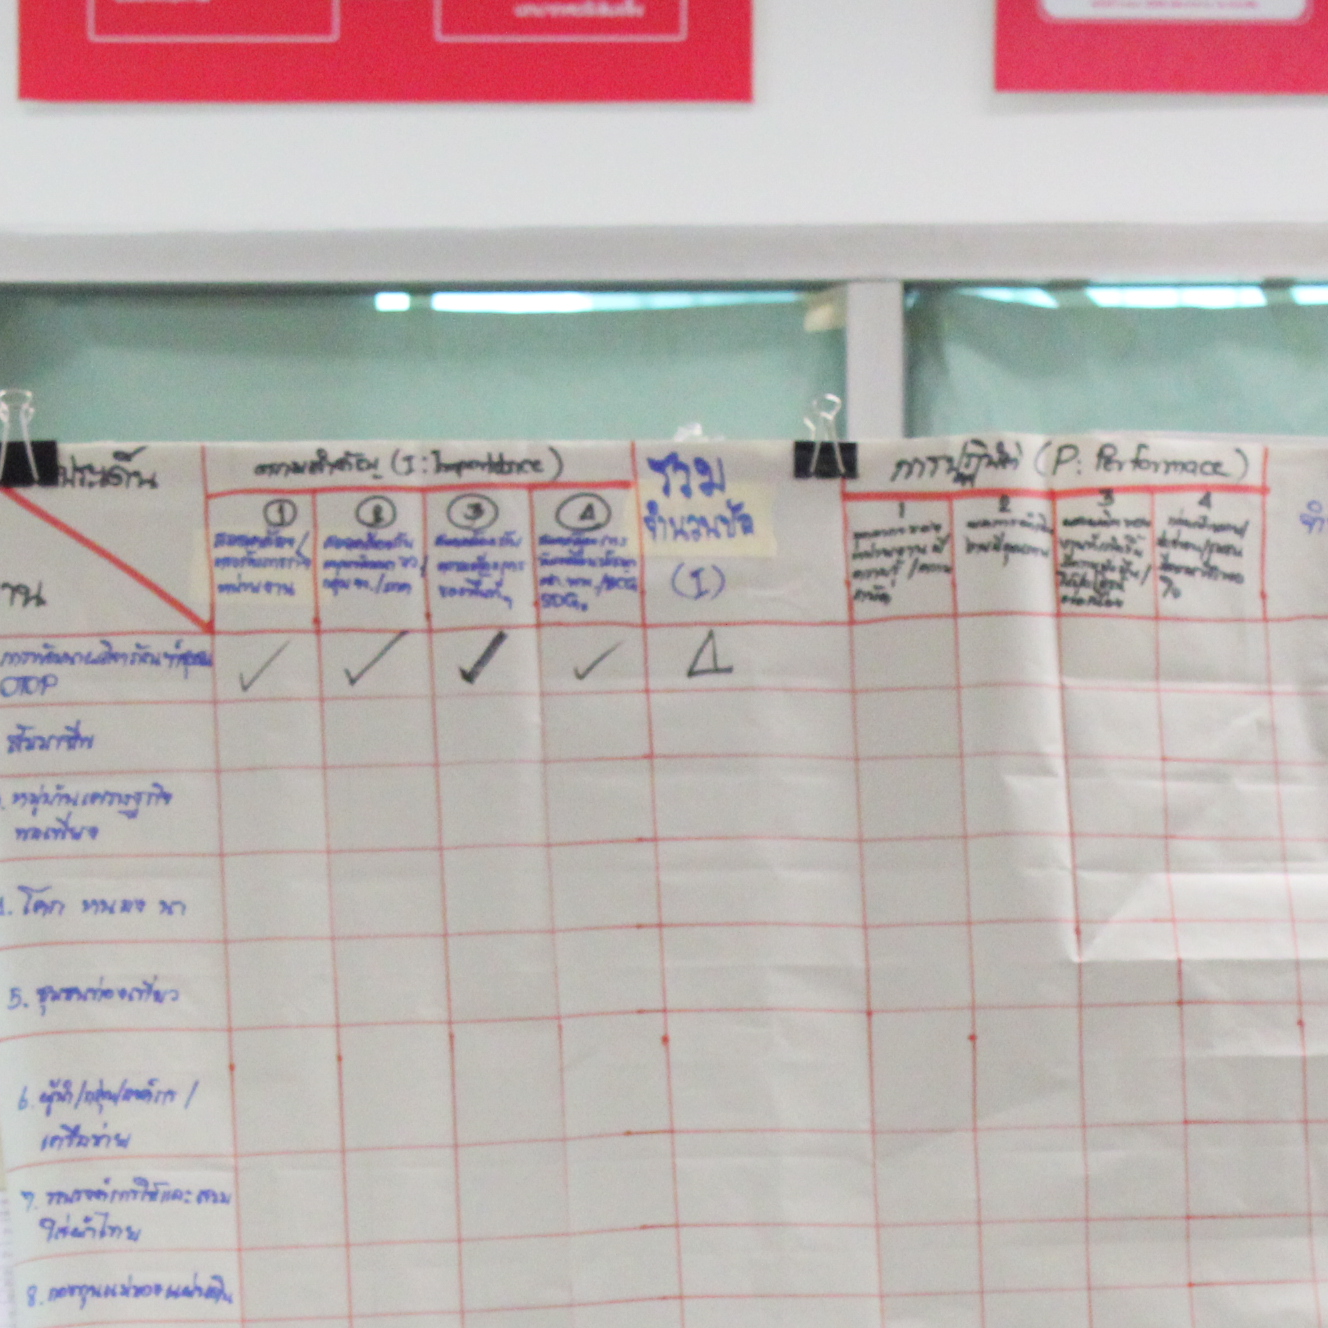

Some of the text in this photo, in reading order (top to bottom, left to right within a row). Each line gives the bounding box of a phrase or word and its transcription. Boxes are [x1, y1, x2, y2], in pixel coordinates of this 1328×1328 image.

[646, 451, 726, 499] รวม
[643, 499, 755, 543] จำนวนข้อ
[671, 562, 726, 600] (I)
